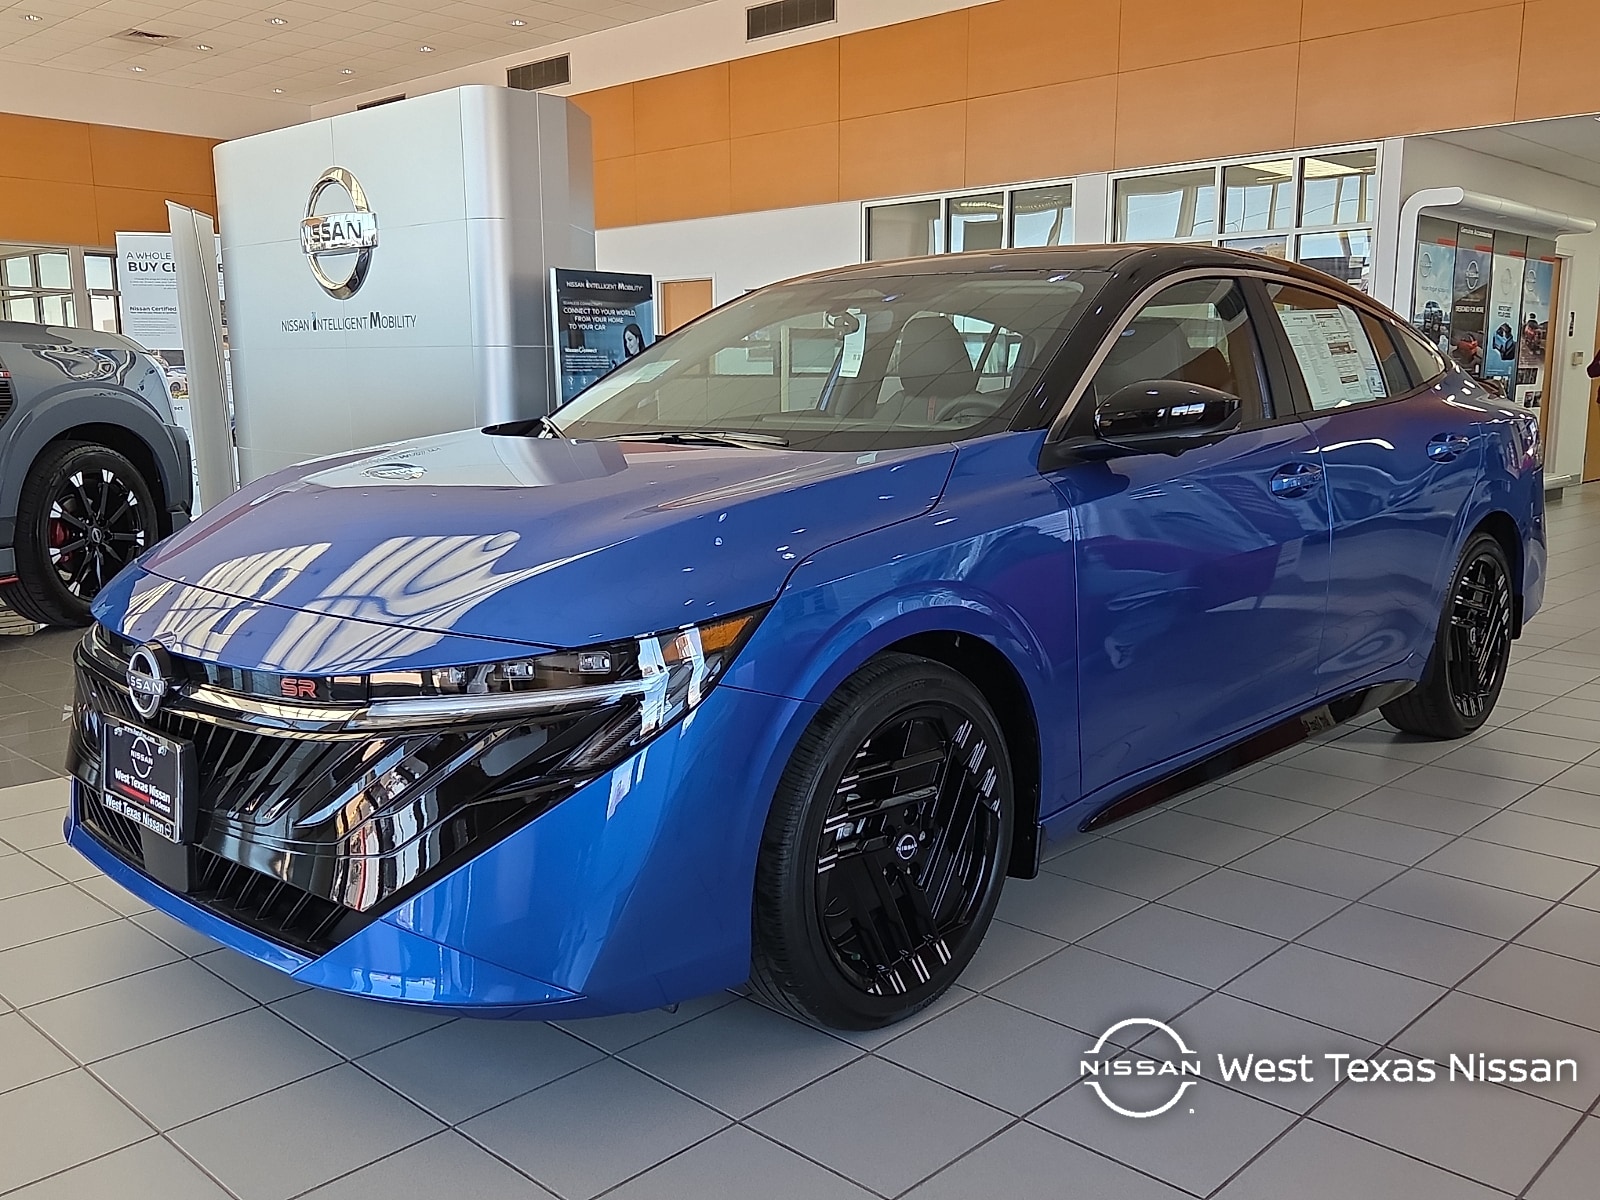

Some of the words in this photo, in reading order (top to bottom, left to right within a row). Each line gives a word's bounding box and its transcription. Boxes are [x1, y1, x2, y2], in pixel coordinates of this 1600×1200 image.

[126, 252, 134, 260] A
[136, 251, 172, 260] WHOLE
[128, 262, 158, 273] BUY
[566, 281, 584, 289] NISSAN
[151, 305, 177, 313] Certified
[563, 307, 591, 316] CONNECT
[601, 309, 616, 317] YOUR
[281, 319, 310, 333] NISSAN
[312, 311, 368, 331] INTELLIGENT
[369, 311, 417, 329] MOBILITY
[574, 315, 591, 323] FROM
[608, 317, 624, 325] HOME
[569, 323, 578, 331] TO
[281, 678, 317, 698] SR
[130, 749, 154, 766] NISSAN
[114, 768, 130, 785] West
[131, 775, 149, 794] Texas
[149, 784, 171, 804] Nissan
[105, 793, 122, 812] West
[123, 801, 141, 821] Texas
[142, 811, 164, 835] Nissan
